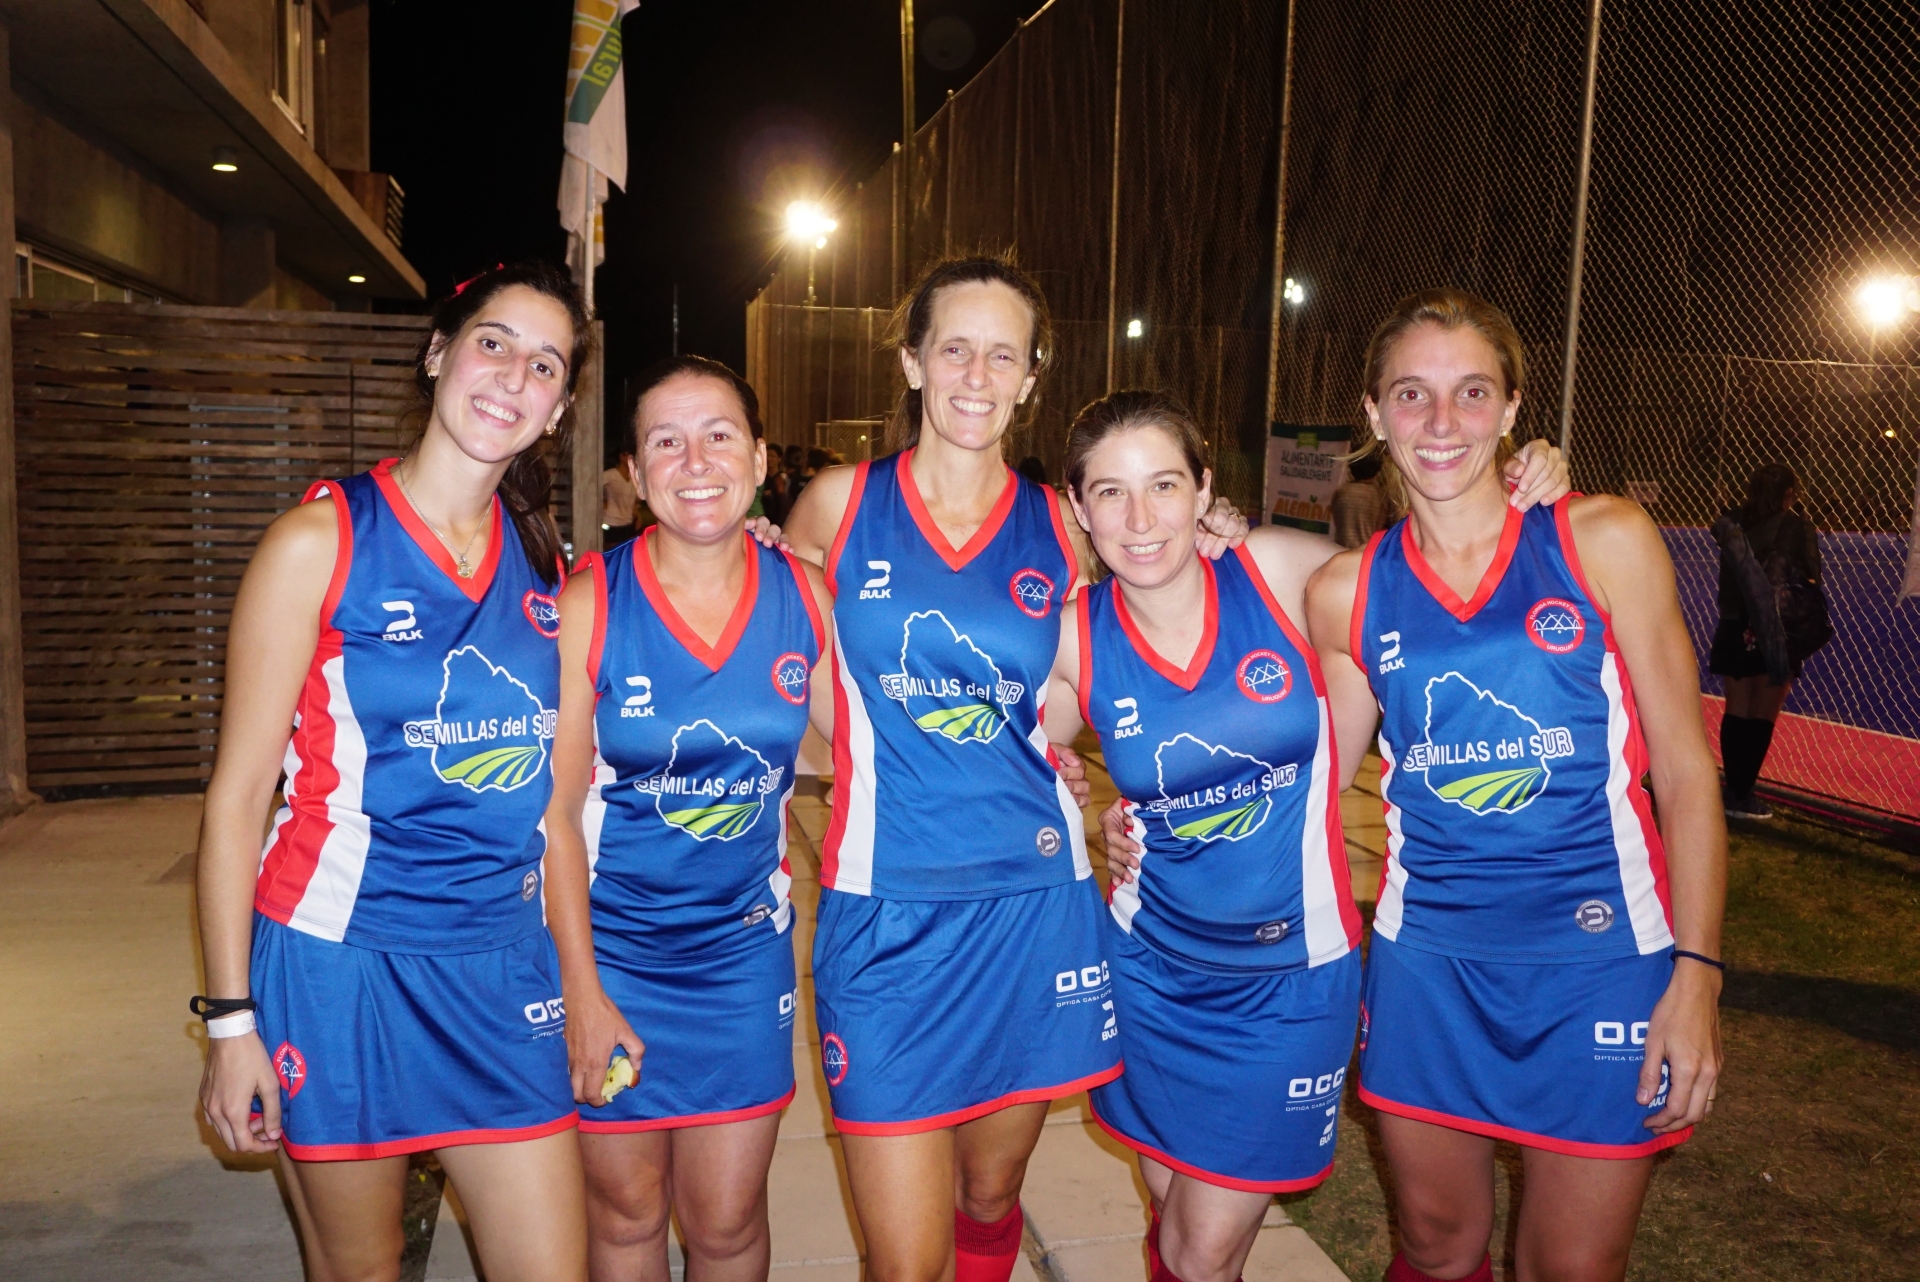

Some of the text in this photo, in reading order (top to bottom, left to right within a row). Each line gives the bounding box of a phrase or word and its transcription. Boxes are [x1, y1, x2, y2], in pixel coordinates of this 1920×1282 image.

[859, 588, 892, 600] BULK
[1530, 600, 1580, 620] FLORIDA HOCKEY CLUB
[382, 629, 424, 641] BULK
[1547, 643, 1574, 652] URUGUAY
[1379, 657, 1406, 675] BULK
[882, 676, 961, 700] SEMILLAS
[966, 683, 990, 701] del
[1261, 688, 1288, 702] URUGUAY
[620, 705, 655, 717] BULK
[407, 718, 498, 745] SEMILLAS
[502, 715, 526, 738] del
[1114, 724, 1144, 739] BULK
[1403, 730, 1572, 769] SEMILLAS del SUR
[635, 768, 782, 798] SEMILLAS del SUR
[1232, 779, 1256, 800] del
[1056, 959, 1110, 993] OCC
[1056, 999, 1081, 1008] OPTICA
[1288, 1066, 1345, 1098] OCC
